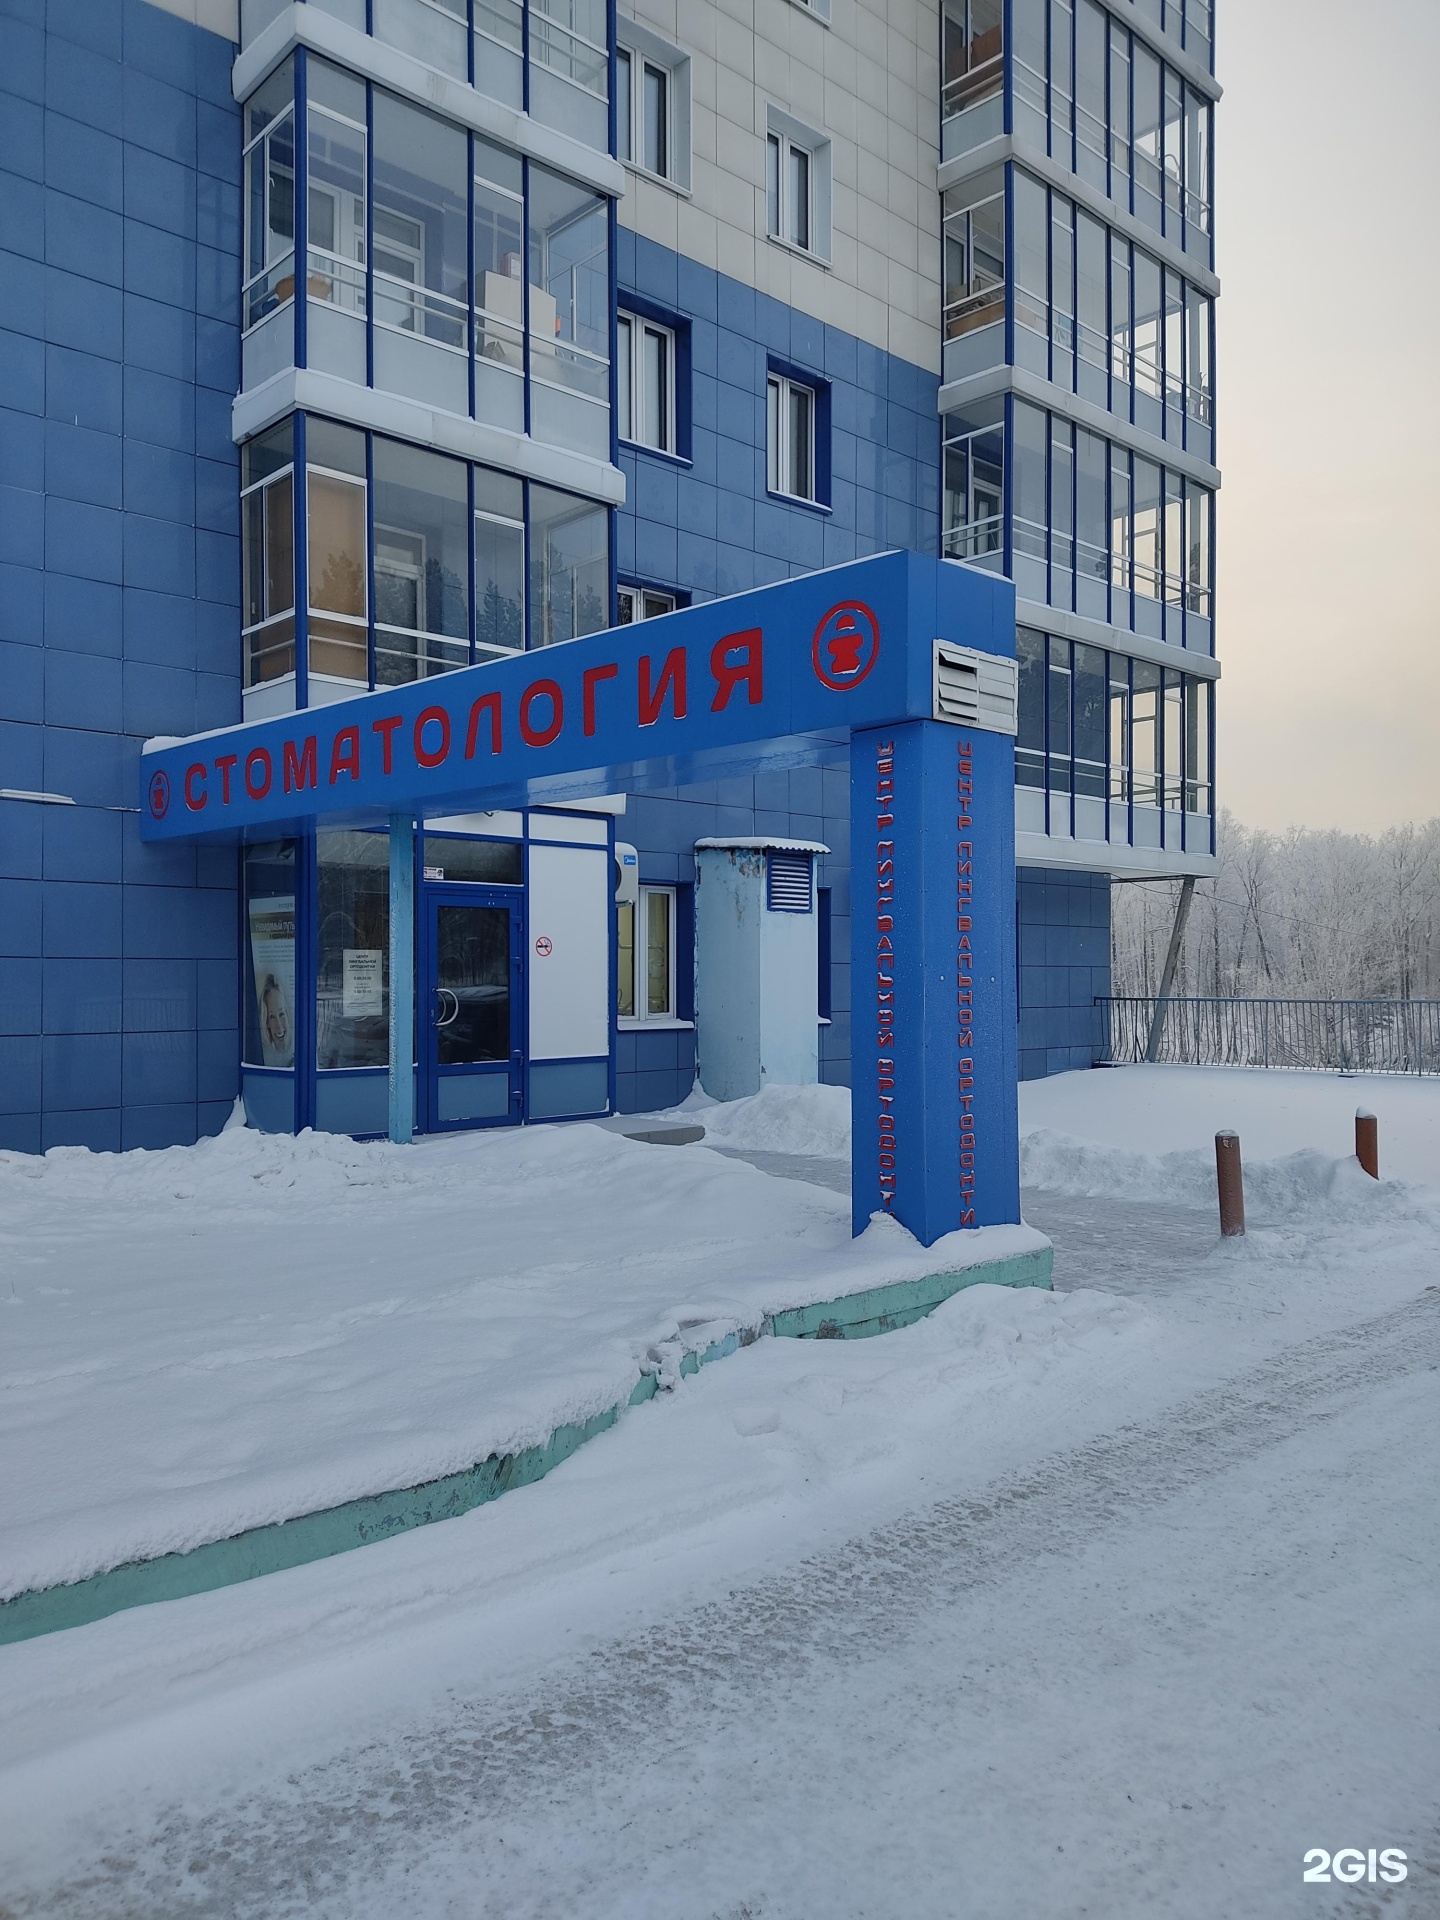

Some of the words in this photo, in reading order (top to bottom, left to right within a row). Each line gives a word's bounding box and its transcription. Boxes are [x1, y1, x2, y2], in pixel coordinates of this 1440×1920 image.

[184, 627, 763, 812] СТОМАТОЛОГИЯ
[876, 740, 895, 832] ЦЕНТР
[957, 740, 973, 831] ЦЕНТР
[877, 1057, 897, 1217] ОРТОДОНТ
